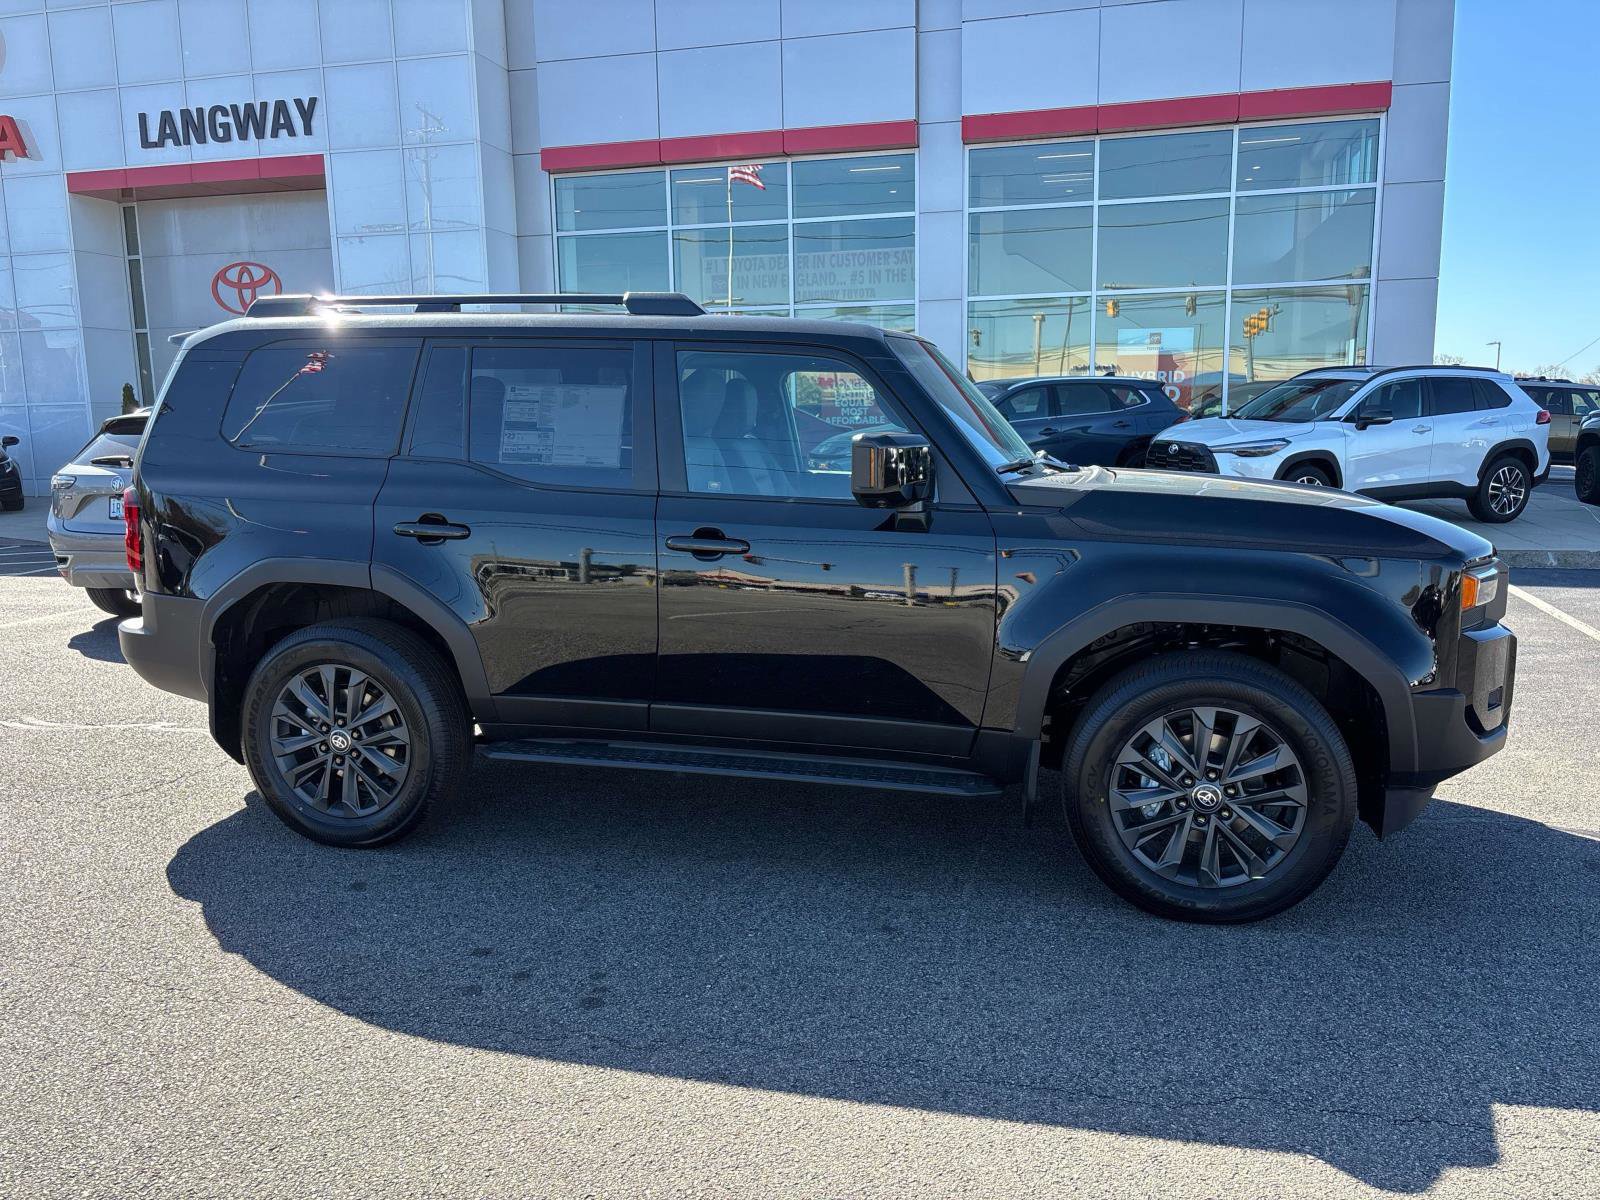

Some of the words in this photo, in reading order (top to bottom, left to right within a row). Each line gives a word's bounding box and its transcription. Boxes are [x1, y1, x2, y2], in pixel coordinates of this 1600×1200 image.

[138, 97, 318, 149] LANGWAY
[704, 259, 719, 274] #1
[768, 254, 809, 272] DEAER
[812, 254, 826, 269] IN
[829, 251, 890, 269] CUSTOMER
[736, 275, 750, 289] IN
[752, 273, 778, 289] NEW
[781, 271, 847, 289] EGLAND...
[868, 270, 882, 284] IN
[885, 268, 907, 283] THE
[825, 415, 886, 425] AFFORDABLE
[841, 407, 869, 416] MOST
[1301, 727, 1337, 817] YOKOHAMA
